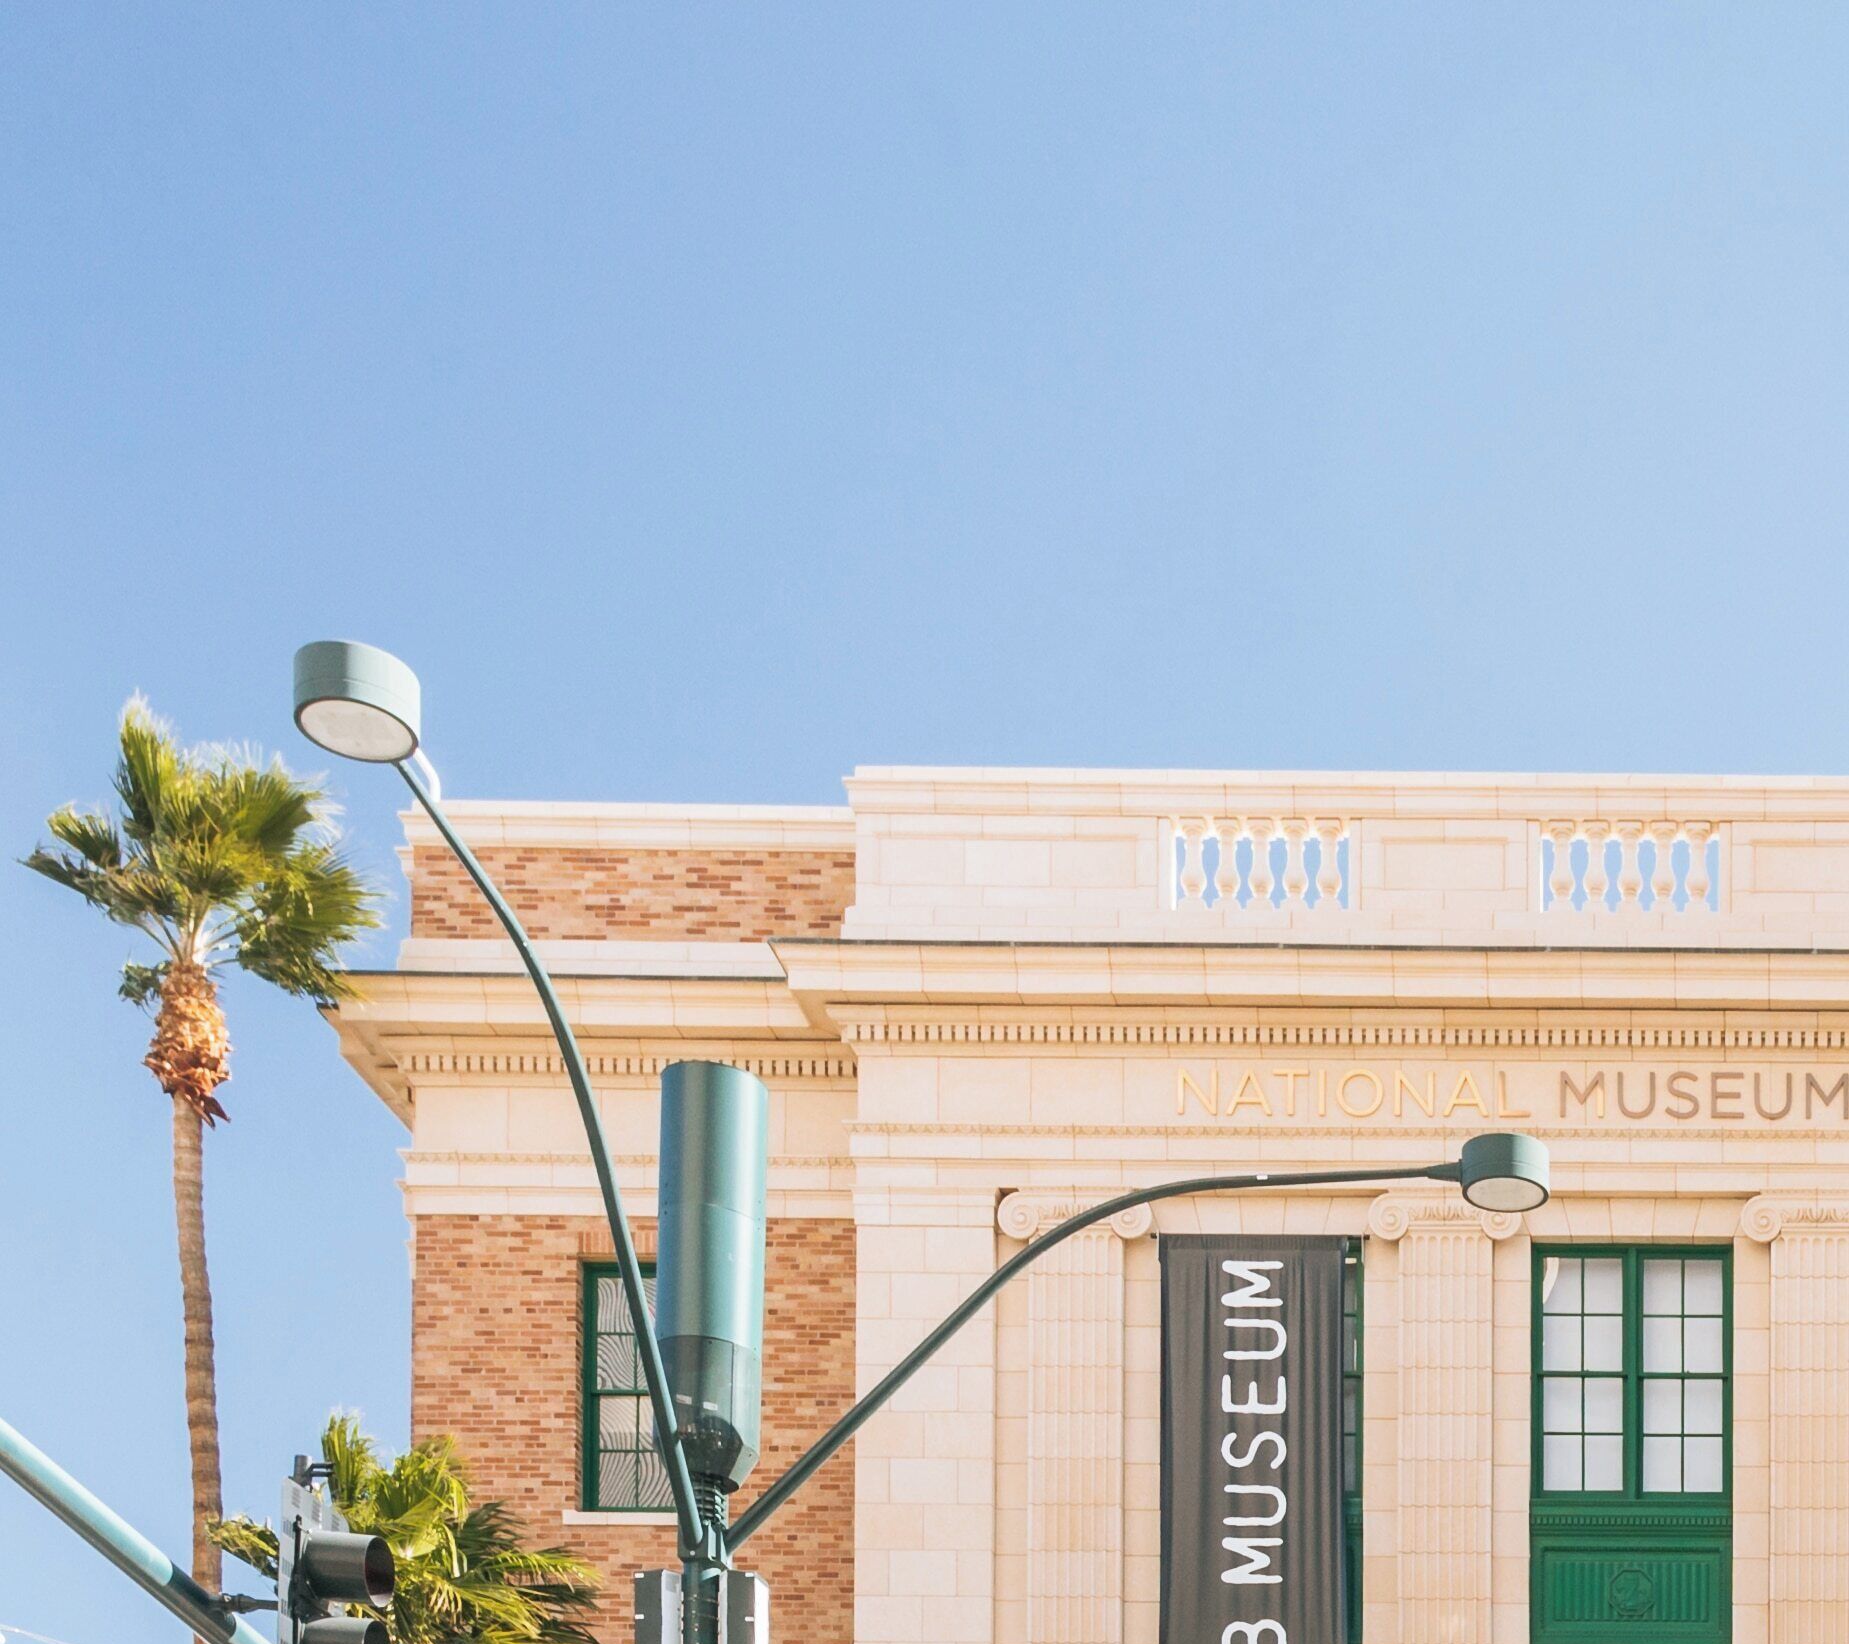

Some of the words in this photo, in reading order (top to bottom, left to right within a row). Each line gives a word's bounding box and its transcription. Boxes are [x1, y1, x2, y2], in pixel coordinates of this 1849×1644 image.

[1177, 1067, 1532, 1119] NATIONAL
[1559, 1070, 1849, 1120] MUSEUM
[1220, 1259, 1288, 1586] MUSEUM
